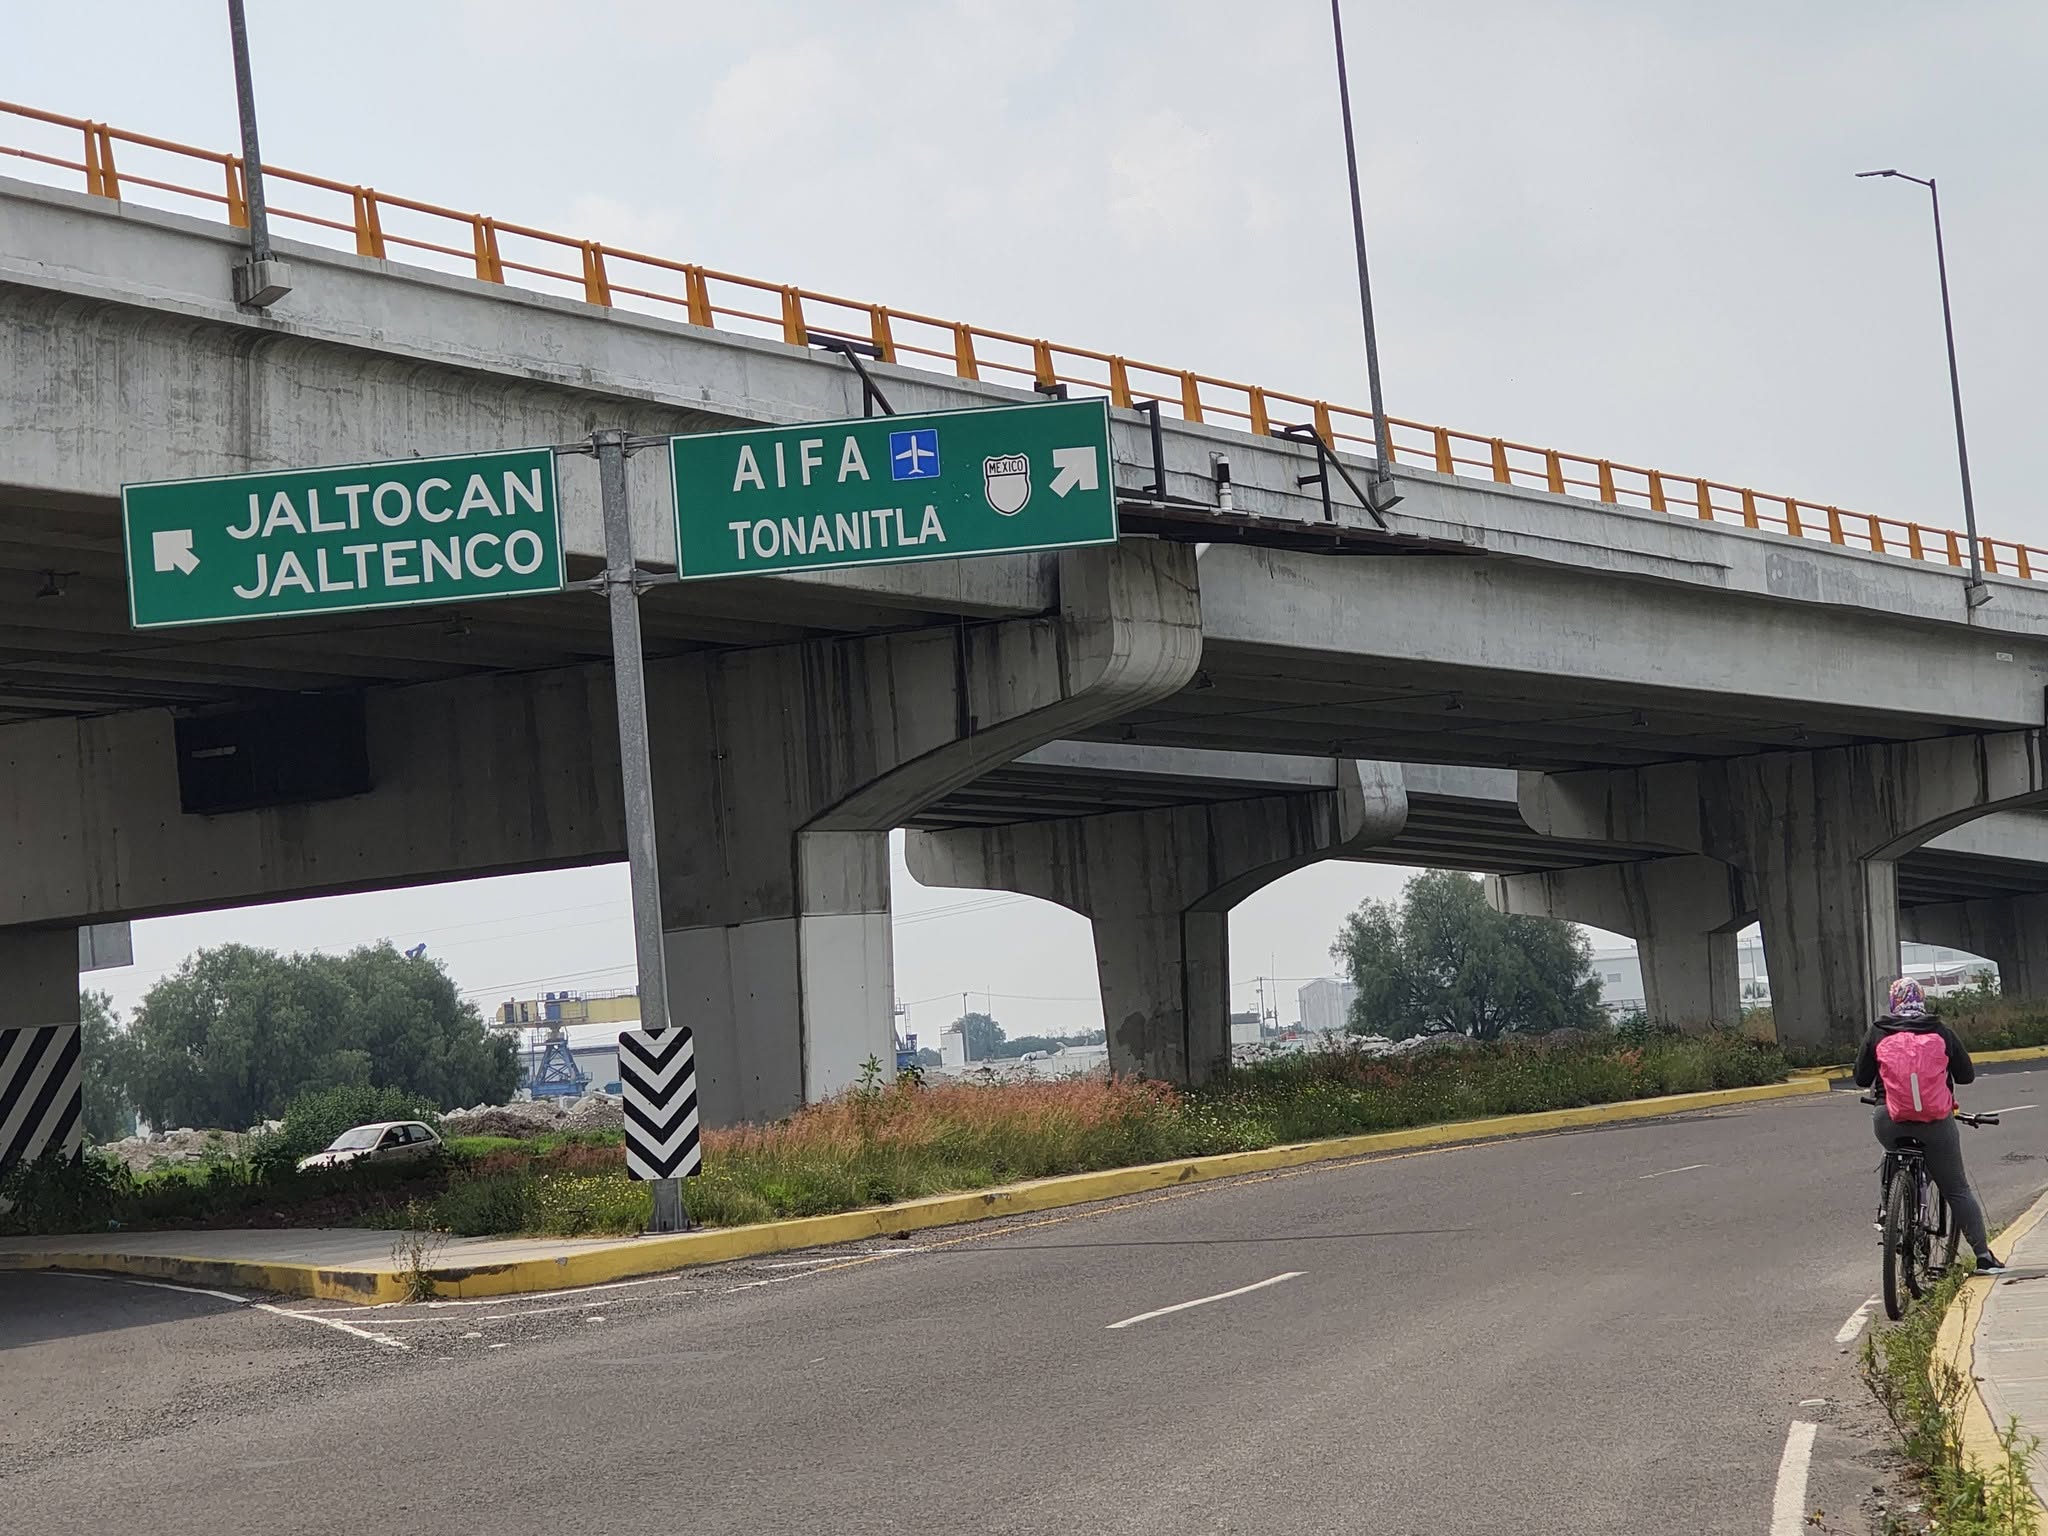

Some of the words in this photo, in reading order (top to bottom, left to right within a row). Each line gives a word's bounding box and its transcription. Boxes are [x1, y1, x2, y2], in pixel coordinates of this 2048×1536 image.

[733, 436, 870, 491] AIFA
[988, 460, 1024, 474] MEXICO
[227, 468, 544, 539] JALTOCAN
[729, 505, 946, 560] TONANITLA
[233, 529, 544, 600] JALTENCO
